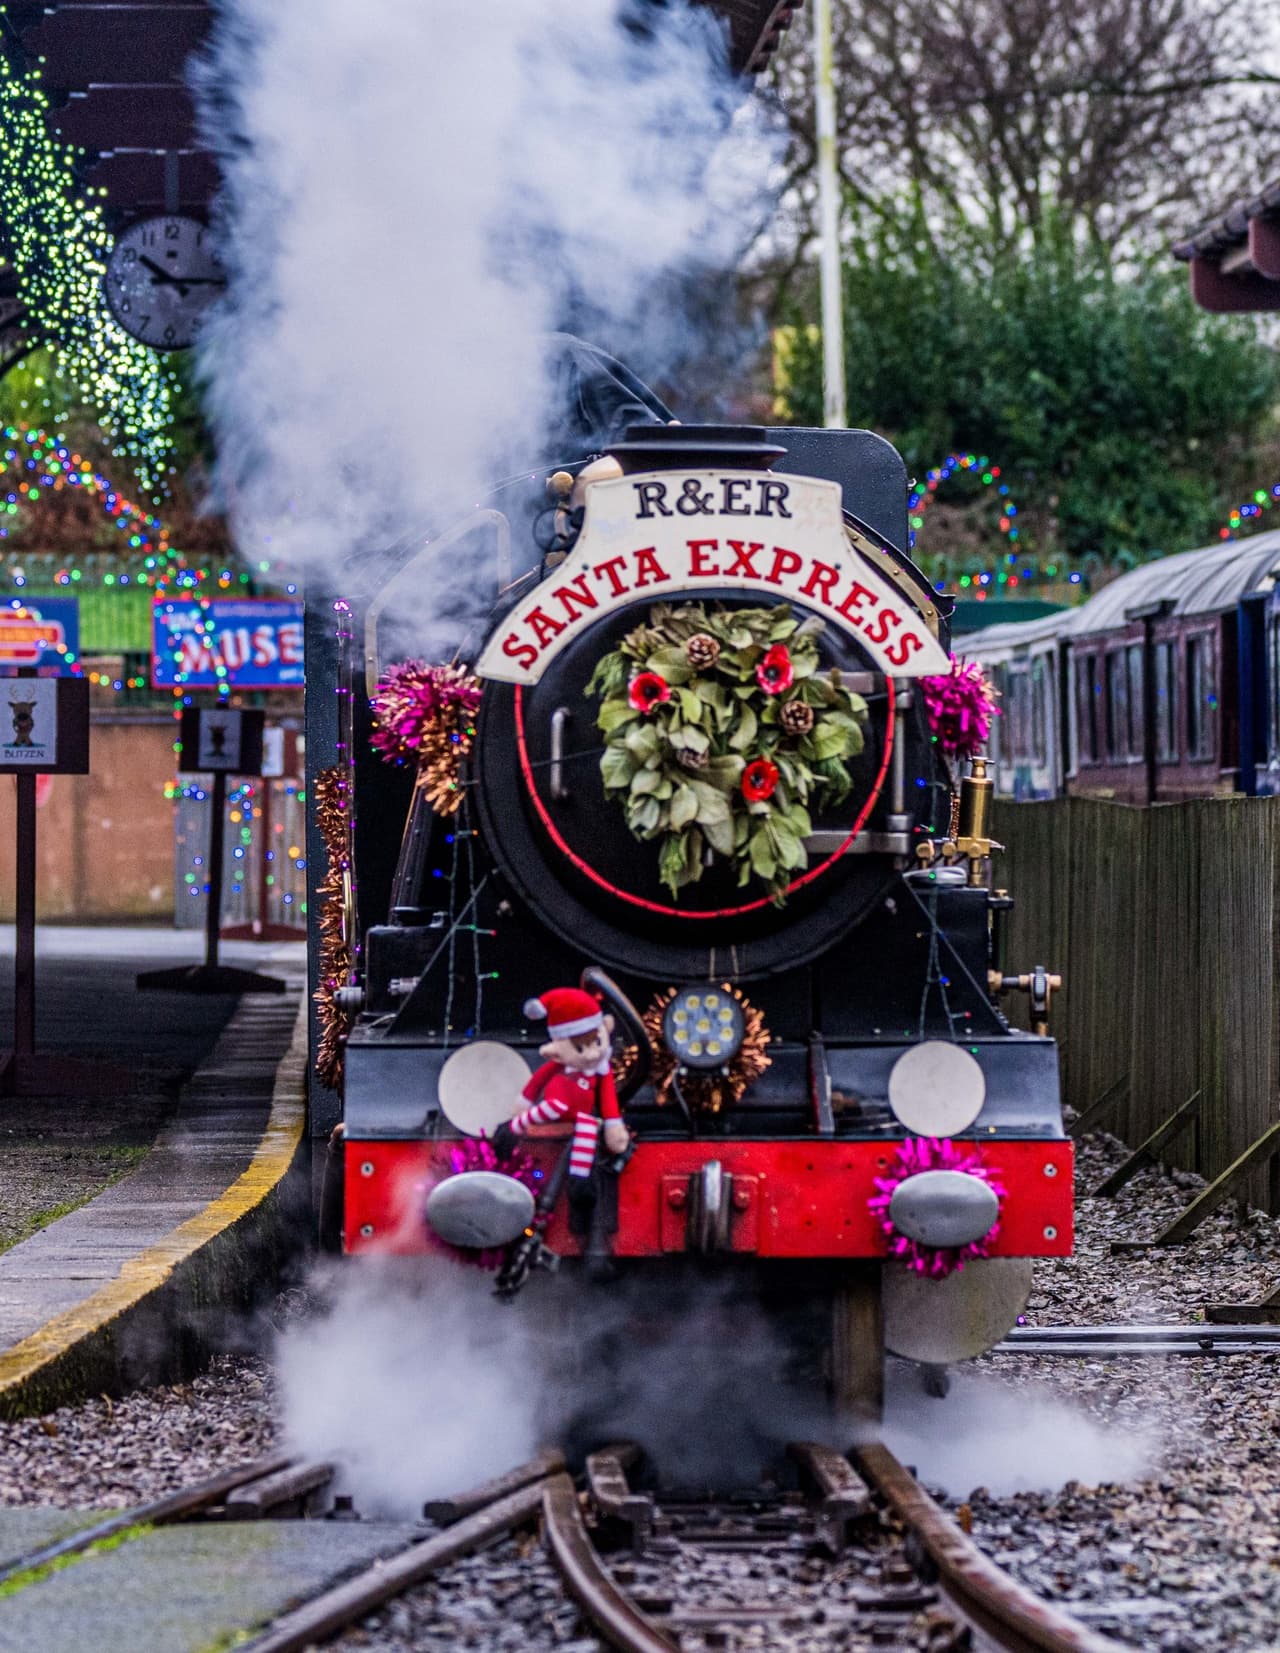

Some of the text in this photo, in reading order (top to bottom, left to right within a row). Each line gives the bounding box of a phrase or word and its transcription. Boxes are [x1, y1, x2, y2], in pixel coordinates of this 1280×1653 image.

[165, 223, 180, 240] 12
[633, 478, 793, 519] R&ER
[502, 538, 924, 670] SANTA EXPRESS
